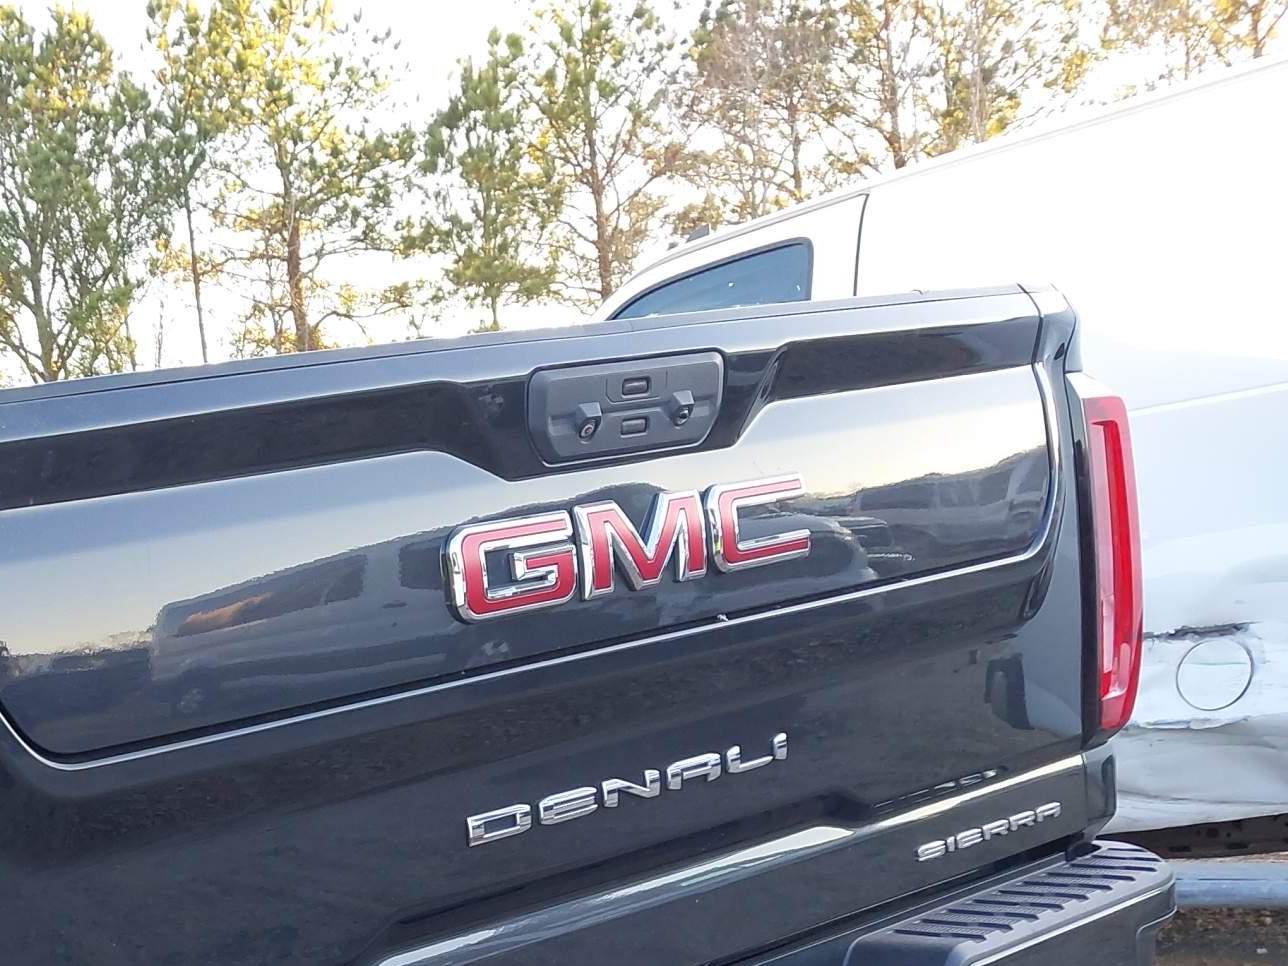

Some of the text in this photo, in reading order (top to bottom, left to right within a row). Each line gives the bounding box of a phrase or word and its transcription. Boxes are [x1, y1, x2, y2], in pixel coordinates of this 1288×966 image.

[444, 472, 811, 621] GMC
[466, 732, 789, 848] DENALI
[916, 801, 1062, 862] SIERRA
